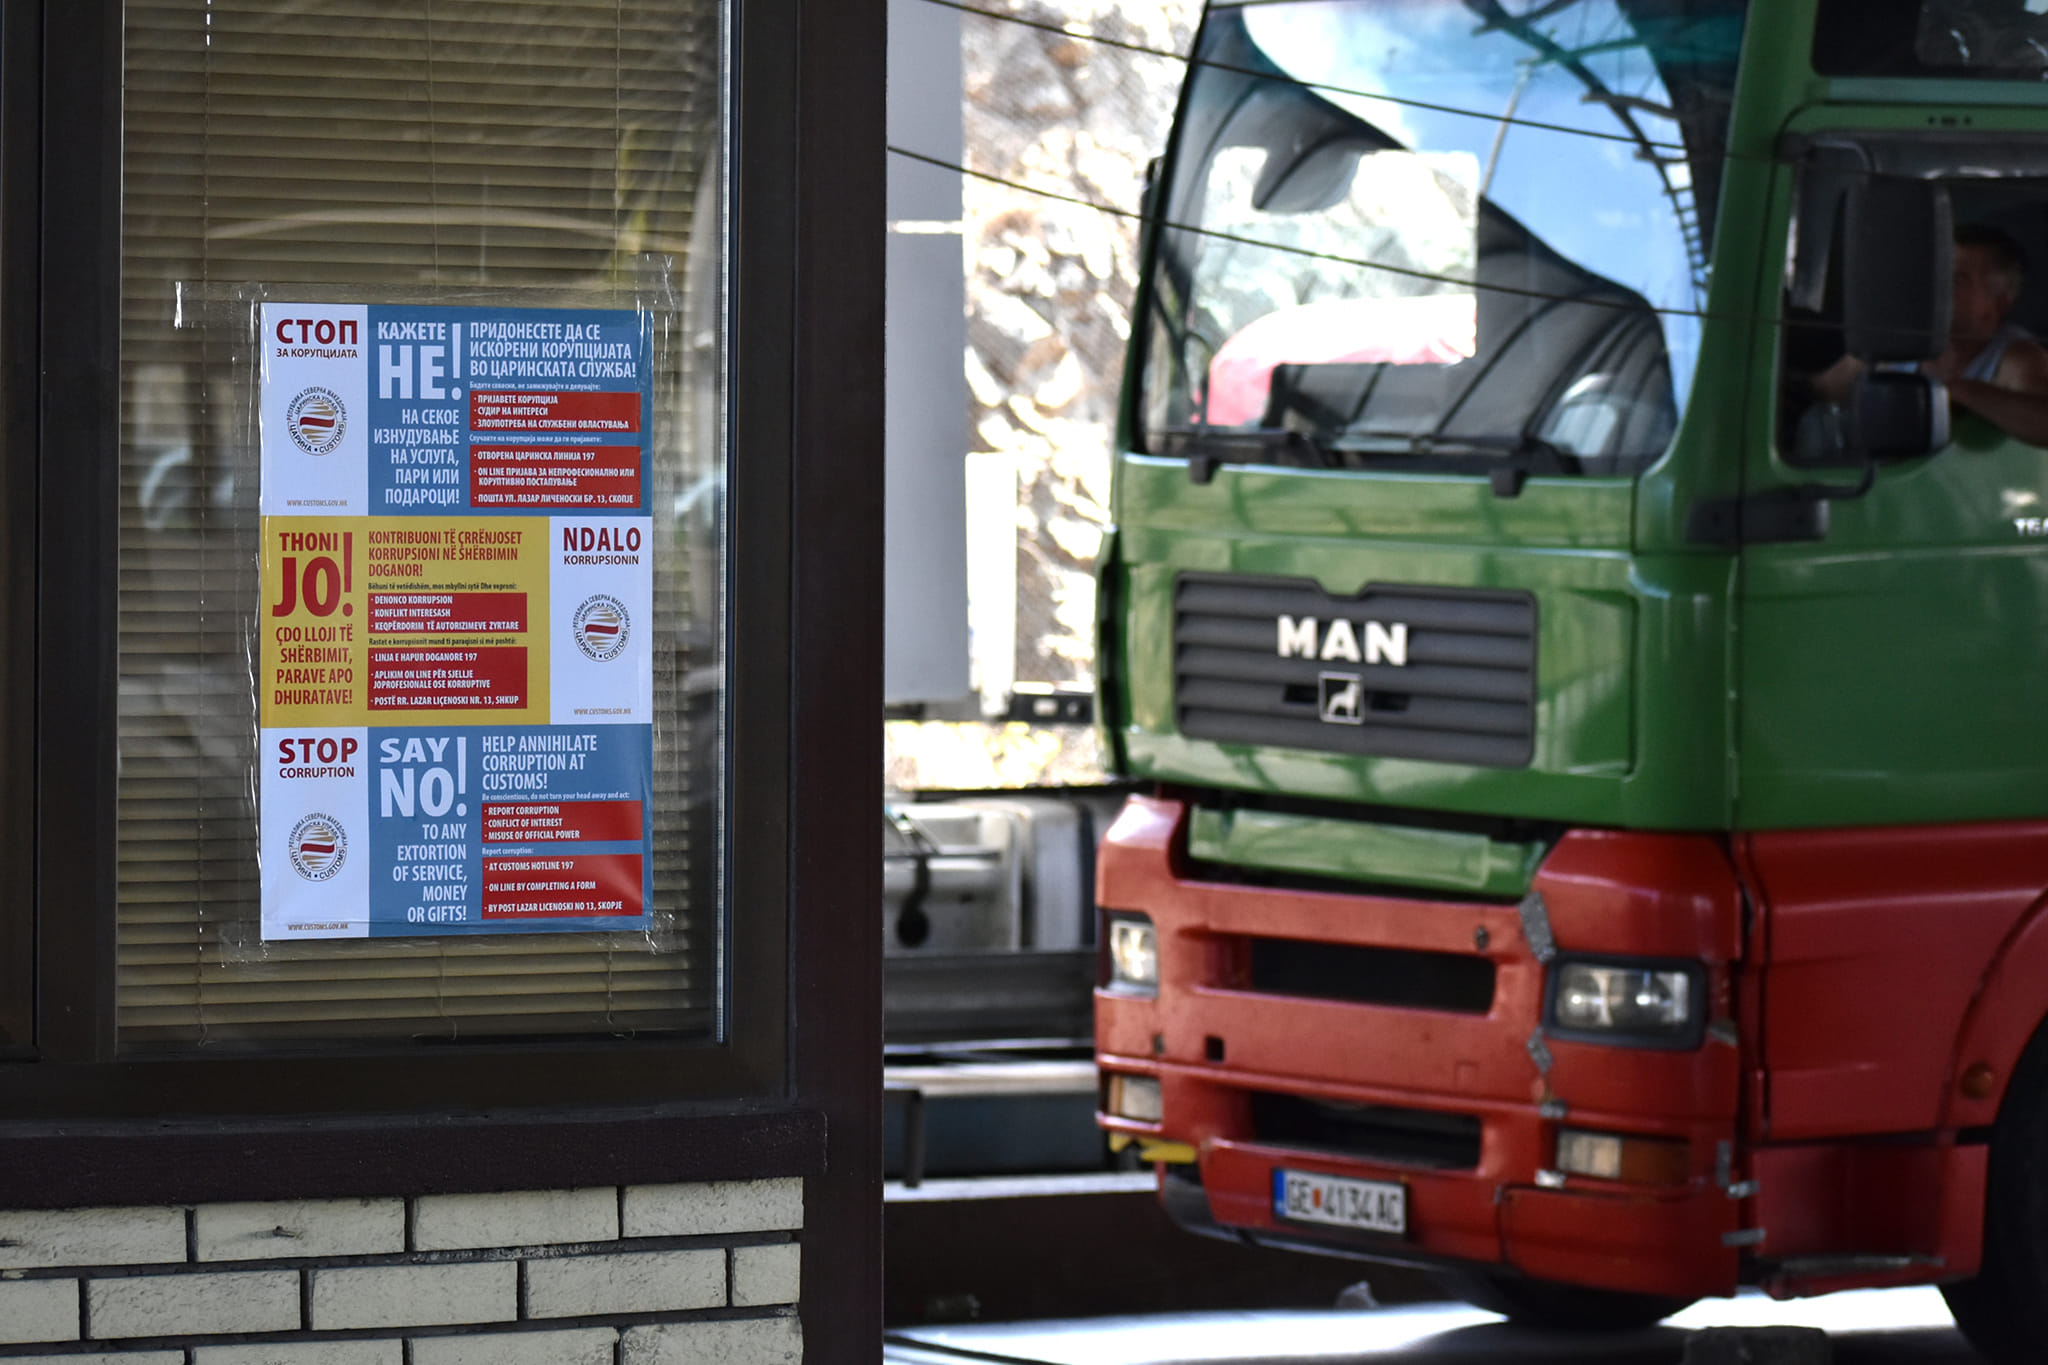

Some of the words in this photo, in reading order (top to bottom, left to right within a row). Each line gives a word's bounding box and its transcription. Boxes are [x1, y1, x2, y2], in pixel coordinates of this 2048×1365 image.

[276, 319, 357, 344] СТОП
[378, 322, 446, 340] КАЖЕТЕ
[470, 322, 562, 342] ПРИДОНЕСЕТЕ
[564, 324, 583, 342] ДА
[585, 324, 600, 340] СЕ
[276, 348, 288, 358] ЗА
[291, 348, 358, 359] КОРУПЦИЈАТА
[470, 341, 538, 358] ИСКОРЕНИ
[541, 343, 632, 361] КОРУПЦИЈАТА
[379, 323, 461, 400] НЕ!
[470, 360, 487, 376] ВО
[490, 361, 576, 379] ЦАРИНСКАТА
[578, 362, 637, 378] СЛУЖБА!
[478, 395, 516, 404] ПРИЈАВЕТЕ
[518, 395, 558, 405] КОРУПЦИЈА
[402, 409, 419, 424] НА
[422, 409, 459, 425] СЕКОЕ
[478, 407, 500, 416] СУДИР
[502, 407, 511, 415] НА
[477, 419, 526, 428] ЗЛОУПОТРЕБА
[538, 420, 577, 429] СЛУЖБЕНИ
[578, 420, 629, 429] ОВЛАСТУВАЊА
[374, 429, 459, 446] ИЗНУДУВАЊЕ
[391, 449, 409, 464] НА
[410, 449, 459, 466] УСЛУГА,
[478, 452, 514, 460] ОТВОРЕНА
[515, 452, 551, 461] ЦАРИНСКА
[583, 453, 595, 461] 197
[395, 469, 430, 484] ПАРИ
[433, 469, 459, 484] ИЛИ
[489, 468, 505, 476] LINE
[506, 468, 537, 476] ПРИЈАВА
[538, 468, 547, 476] ЗА
[548, 468, 618, 477] НЕПРОФЕСИОНАЛНО
[479, 478, 525, 486] КОРУПТИВНО
[526, 478, 577, 486] ПОСТАПУВАЊЕ
[385, 488, 459, 506] ПОДАРОЦИ!
[478, 495, 504, 503] ПОШТА
[279, 532, 338, 551] THONI
[369, 531, 441, 544] KONTRIBUONI
[443, 528, 456, 544] TË
[458, 529, 522, 548] ÇRRËNJOSET
[563, 527, 641, 552] NDALO
[369, 548, 440, 560] KORRUPSIONI
[443, 545, 456, 560] NË
[458, 545, 518, 560] SHËRBIMIN
[564, 555, 639, 565] KORRUPSIONIN
[272, 532, 353, 617] JO!
[369, 564, 423, 577] DOGANOR!
[375, 609, 407, 617] KONFLIKT
[409, 609, 450, 617] INTERESASH
[375, 620, 424, 631] KEQPËRDORIM
[427, 620, 435, 630] TË
[436, 621, 487, 630] AUTORIZIMEVE
[489, 621, 519, 630] ZYRTARE
[276, 627, 302, 646] ÇDO
[305, 627, 336, 642] LLOJI
[340, 623, 353, 642] TË
[1277, 614, 1407, 666] MAN
[280, 645, 353, 665] SHËRBIMIT,
[375, 653, 394, 662] LINJA
[395, 653, 399, 662] E
[401, 653, 424, 662] HAPUR
[425, 653, 463, 662] DOGANORE
[465, 653, 477, 661] 197
[276, 668, 326, 684] PARAVE
[328, 668, 353, 683] APO
[375, 670, 403, 679] APLIKIM
[405, 670, 415, 679] ON
[416, 670, 431, 679] LINE
[433, 668, 446, 679] PËR
[448, 670, 473, 679] SJELLJE
[275, 689, 353, 705] DHURATAVE!
[375, 695, 395, 706] POSTË
[279, 738, 358, 764] STOP
[380, 737, 450, 763] SAY
[483, 736, 516, 752] HELP
[519, 735, 597, 752] ANNIHILATE
[483, 754, 566, 771] CORRUPTION
[569, 754, 586, 770] AT
[279, 767, 354, 779] CORRUPTION
[380, 736, 467, 818] NO!
[483, 773, 548, 790] CUSTOMS!
[488, 807, 514, 816] REPORT
[516, 806, 559, 815] CORRUPTION
[488, 819, 519, 828] CONFLICT
[521, 819, 530, 827] OF
[531, 818, 563, 827] INTEREST
[422, 824, 439, 840] TO
[441, 824, 466, 839] ANY
[488, 831, 513, 840] MISUSE
[515, 831, 523, 840] OF
[525, 830, 554, 839] OFFICIAL
[555, 830, 580, 839] POWER
[398, 844, 466, 861] EXTORTION
[393, 866, 409, 881] OF
[412, 864, 467, 882] SERVICE,
[489, 862, 498, 871] AT
[499, 862, 530, 871] CUSTOMS
[531, 861, 560, 870] HOTLINE
[561, 861, 574, 870] 197
[423, 885, 467, 901] MONEY
[489, 883, 499, 892] ON
[500, 882, 515, 891] LINE
[517, 882, 525, 891] BY
[527, 881, 569, 891] COMPLETING
[571, 881, 575, 890] A
[577, 881, 596, 890] FORM
[407, 907, 425, 922] OR
[427, 905, 466, 922] GIFTS!
[489, 904, 497, 913] BY
[498, 903, 515, 912] POST
[517, 902, 538, 912] LAZAR
[539, 902, 573, 911] LICENOSKI
[575, 902, 585, 911] NO
[586, 902, 596, 911] 13,
[598, 901, 623, 910] SKOPJE
